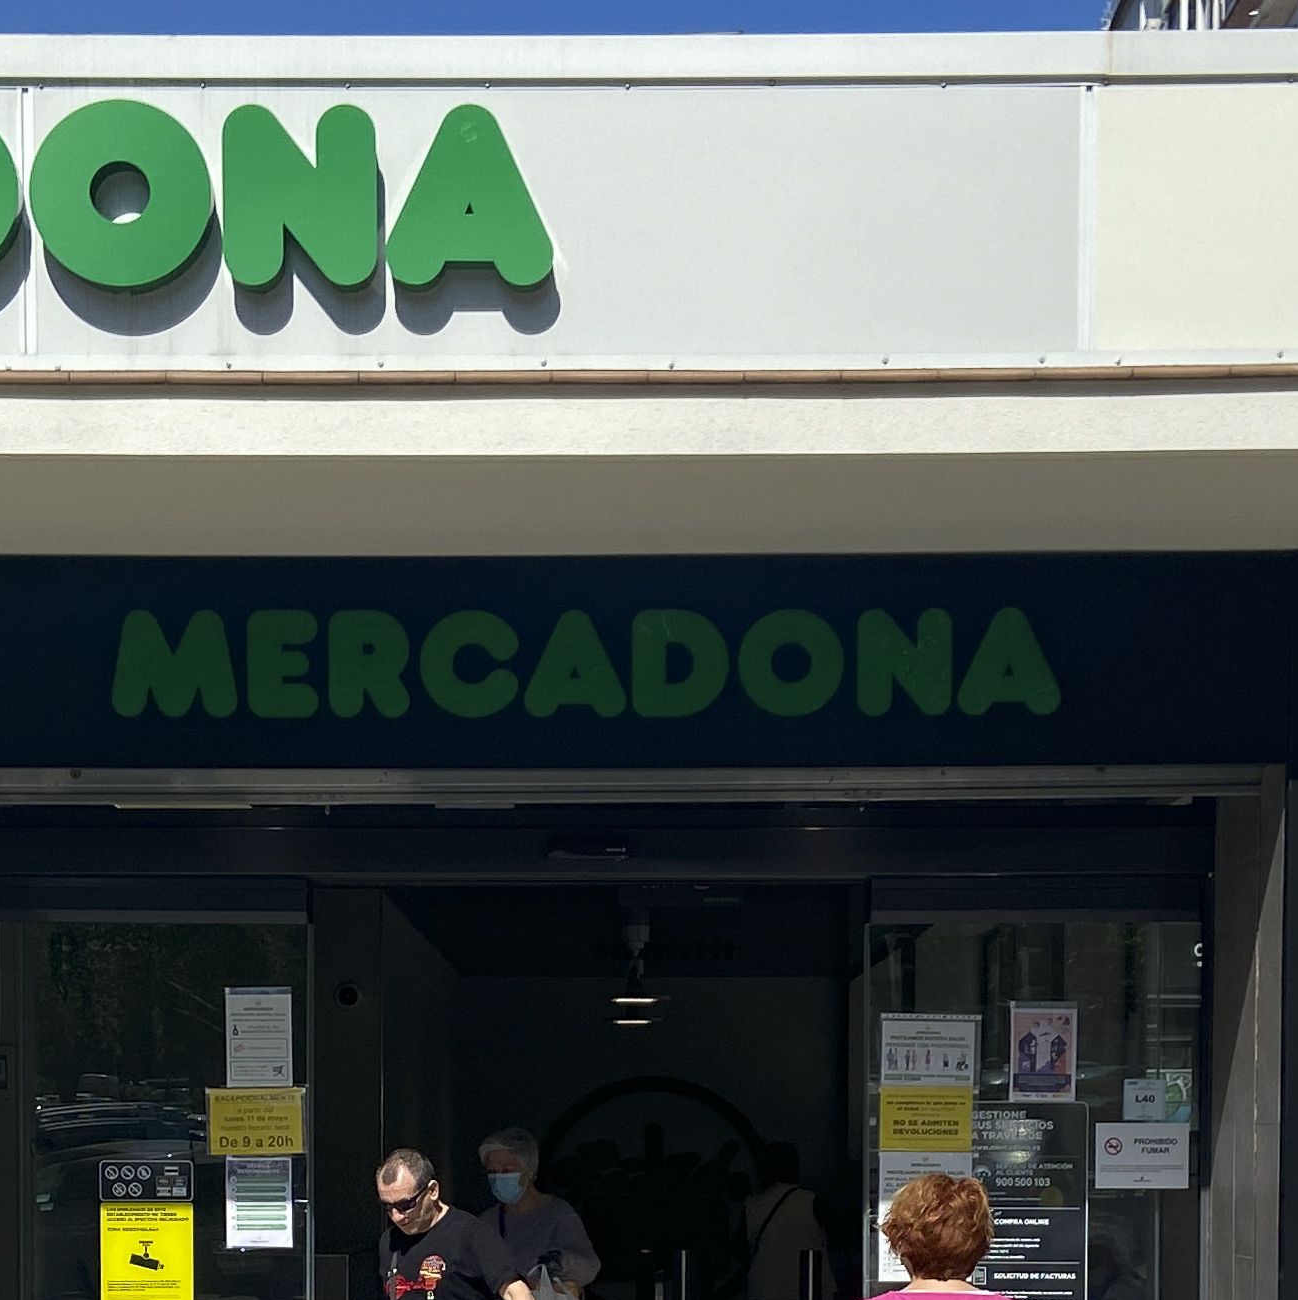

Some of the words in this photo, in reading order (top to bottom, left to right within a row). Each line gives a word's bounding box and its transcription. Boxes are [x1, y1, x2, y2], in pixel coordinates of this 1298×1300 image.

[112, 605, 1062, 719] MERCADONA
[1134, 1094, 1156, 1104] L40
[972, 1110, 1027, 1119] GESTIONE
[892, 1128, 959, 1136] DEVOLUCIONES
[982, 1131, 1027, 1141] TRAV
[219, 1135, 238, 1148] De
[242, 1135, 251, 1148] 9
[255, 1137, 264, 1148] a
[268, 1135, 294, 1148] 20h
[1133, 1138, 1178, 1146] PROHIBIDO
[1141, 1146, 1170, 1154] FUMAR
[995, 1177, 1014, 1187] 900
[1014, 1177, 1033, 1187] 500
[1033, 1177, 1051, 1187] 103
[993, 1218, 1024, 1226] COMPRA
[1024, 1218, 1050, 1226] ONLINE
[993, 1272, 1029, 1280] SOLICITUD
[1030, 1272, 1040, 1280] DE
[1040, 1272, 1076, 1280] FACTURAS
